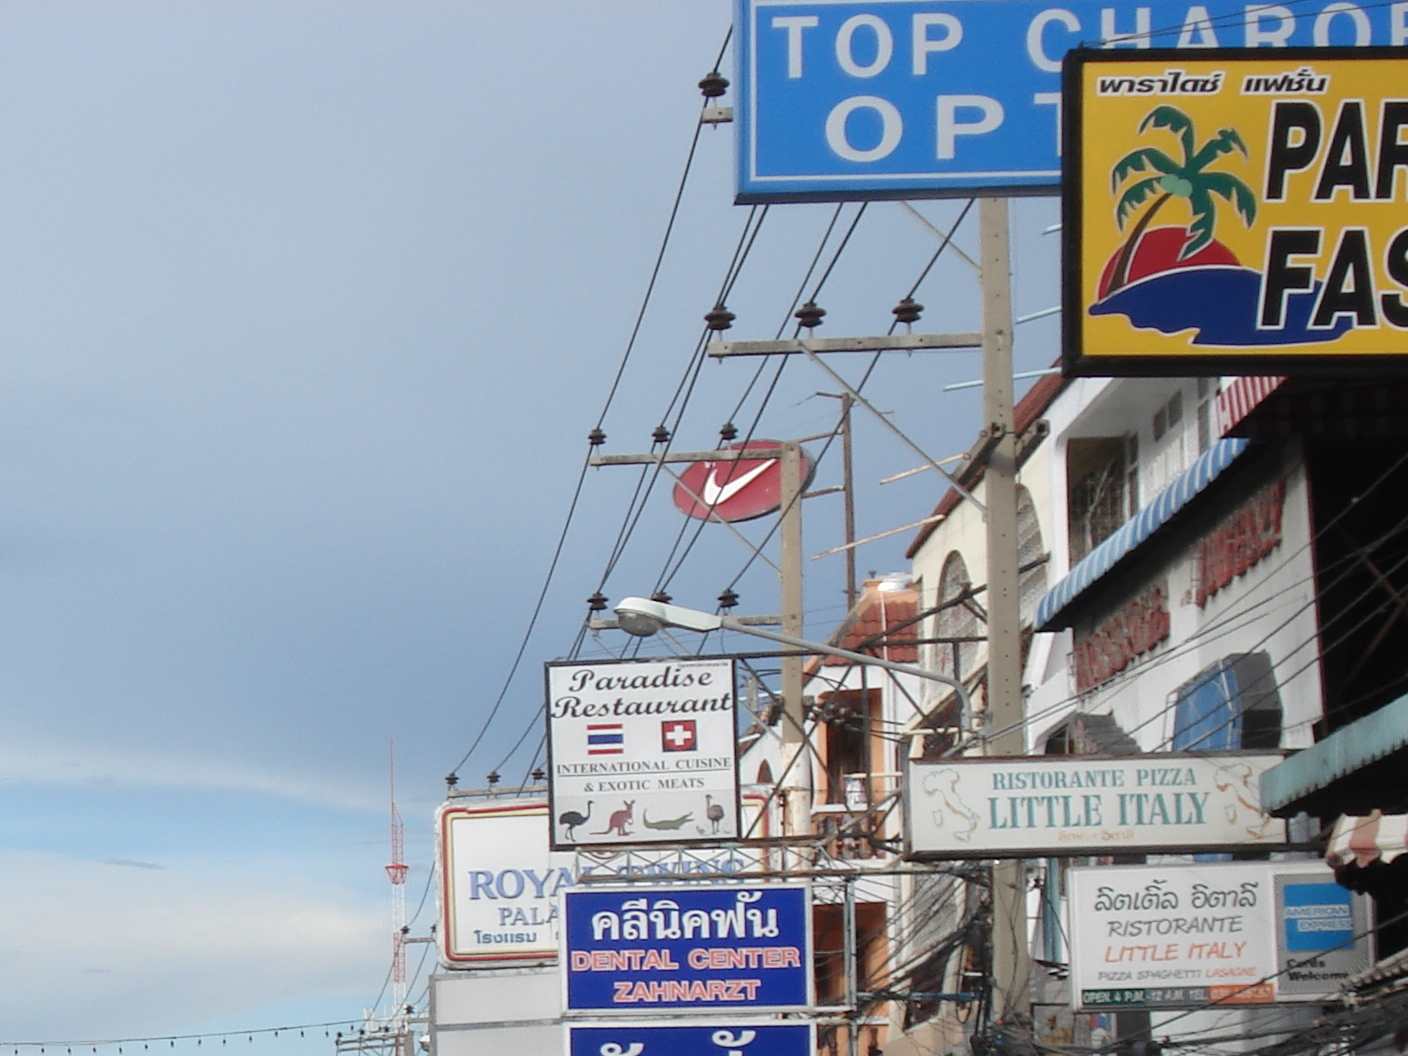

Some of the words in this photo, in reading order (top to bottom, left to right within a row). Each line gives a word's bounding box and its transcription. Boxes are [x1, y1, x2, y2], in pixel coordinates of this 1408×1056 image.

[771, 13, 964, 79] TOP
[1026, 2, 1408, 73] CHARO
[569, 666, 713, 692] Paradise
[551, 692, 734, 719] Restaurant
[557, 760, 669, 775] INTERNATIONAL
[676, 757, 732, 770] CUISINE
[583, 783, 595, 793] &
[598, 779, 651, 792] EXOTIC
[658, 778, 705, 789] MEATS
[993, 769, 1124, 790] RISTORANTE
[1136, 768, 1197, 787] PIZZA
[988, 794, 1103, 830] LITTLE
[1118, 792, 1211, 826] ITALY
[1094, 879, 1179, 911] ลิตเติ้ล
[1191, 882, 1259, 909] อิตาลี
[592, 891, 780, 941] คลีนิคฟัน
[1286, 907, 1348, 917] AMERICAN
[1107, 916, 1244, 938] RISTORANTE
[1299, 920, 1354, 931] EXPRESS
[571, 950, 679, 972] DENTAL
[688, 946, 801, 970] CENTER
[1104, 943, 1180, 964] LITTLE
[1188, 941, 1248, 960] ITALY
[1097, 971, 1133, 981] PIZZA
[1137, 969, 1202, 981] SPAGHETTI
[1205, 967, 1257, 979] LASAGNE
[612, 979, 762, 1003] ZAHNARZT
